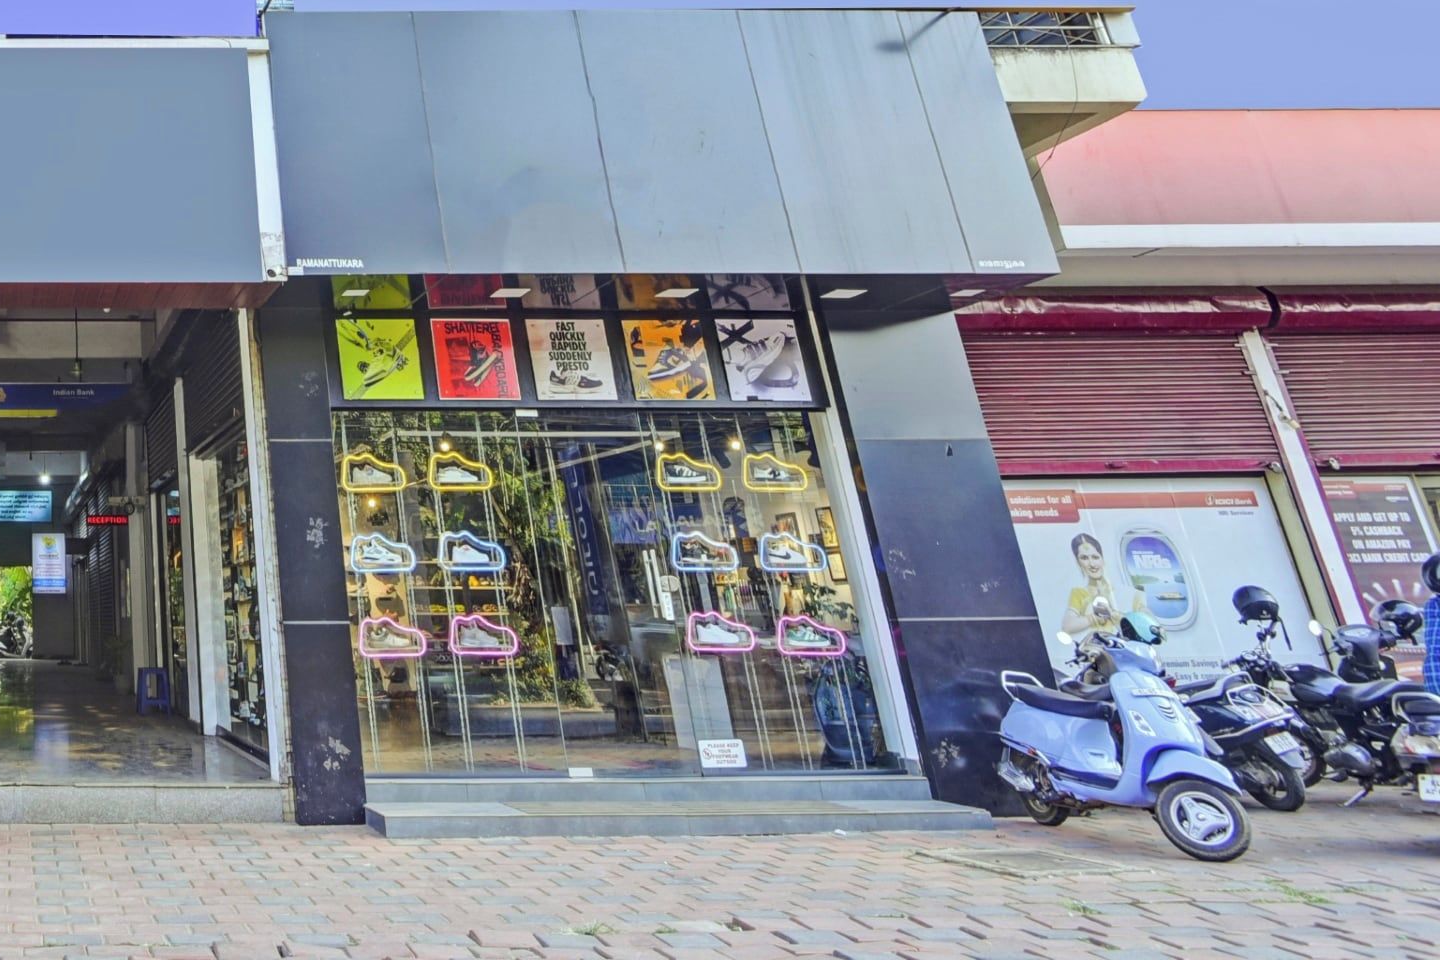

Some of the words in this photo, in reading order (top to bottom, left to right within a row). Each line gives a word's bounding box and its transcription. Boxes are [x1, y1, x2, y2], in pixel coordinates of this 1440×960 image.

[296, 258, 364, 268] RAMANATTUKARA
[555, 322, 576, 331] FAST
[549, 331, 585, 341] QUICKLY
[550, 341, 587, 351] RAPIDLY
[549, 351, 592, 361] SUDDENLY
[52, 388, 75, 396] Indian
[76, 388, 95, 396] Bank
[1009, 495, 1046, 504] solutions
[1047, 495, 1059, 504] for
[1060, 495, 1072, 504] all
[1010, 507, 1033, 519] nking
[1034, 507, 1059, 517] needs
[1356, 512, 1372, 522] AND
[1373, 512, 1387, 522] GET
[1399, 512, 1411, 522] TO
[87, 515, 128, 524] RECEPTION
[1162, 659, 1190, 667] remium
[1191, 659, 1219, 669] Savings
